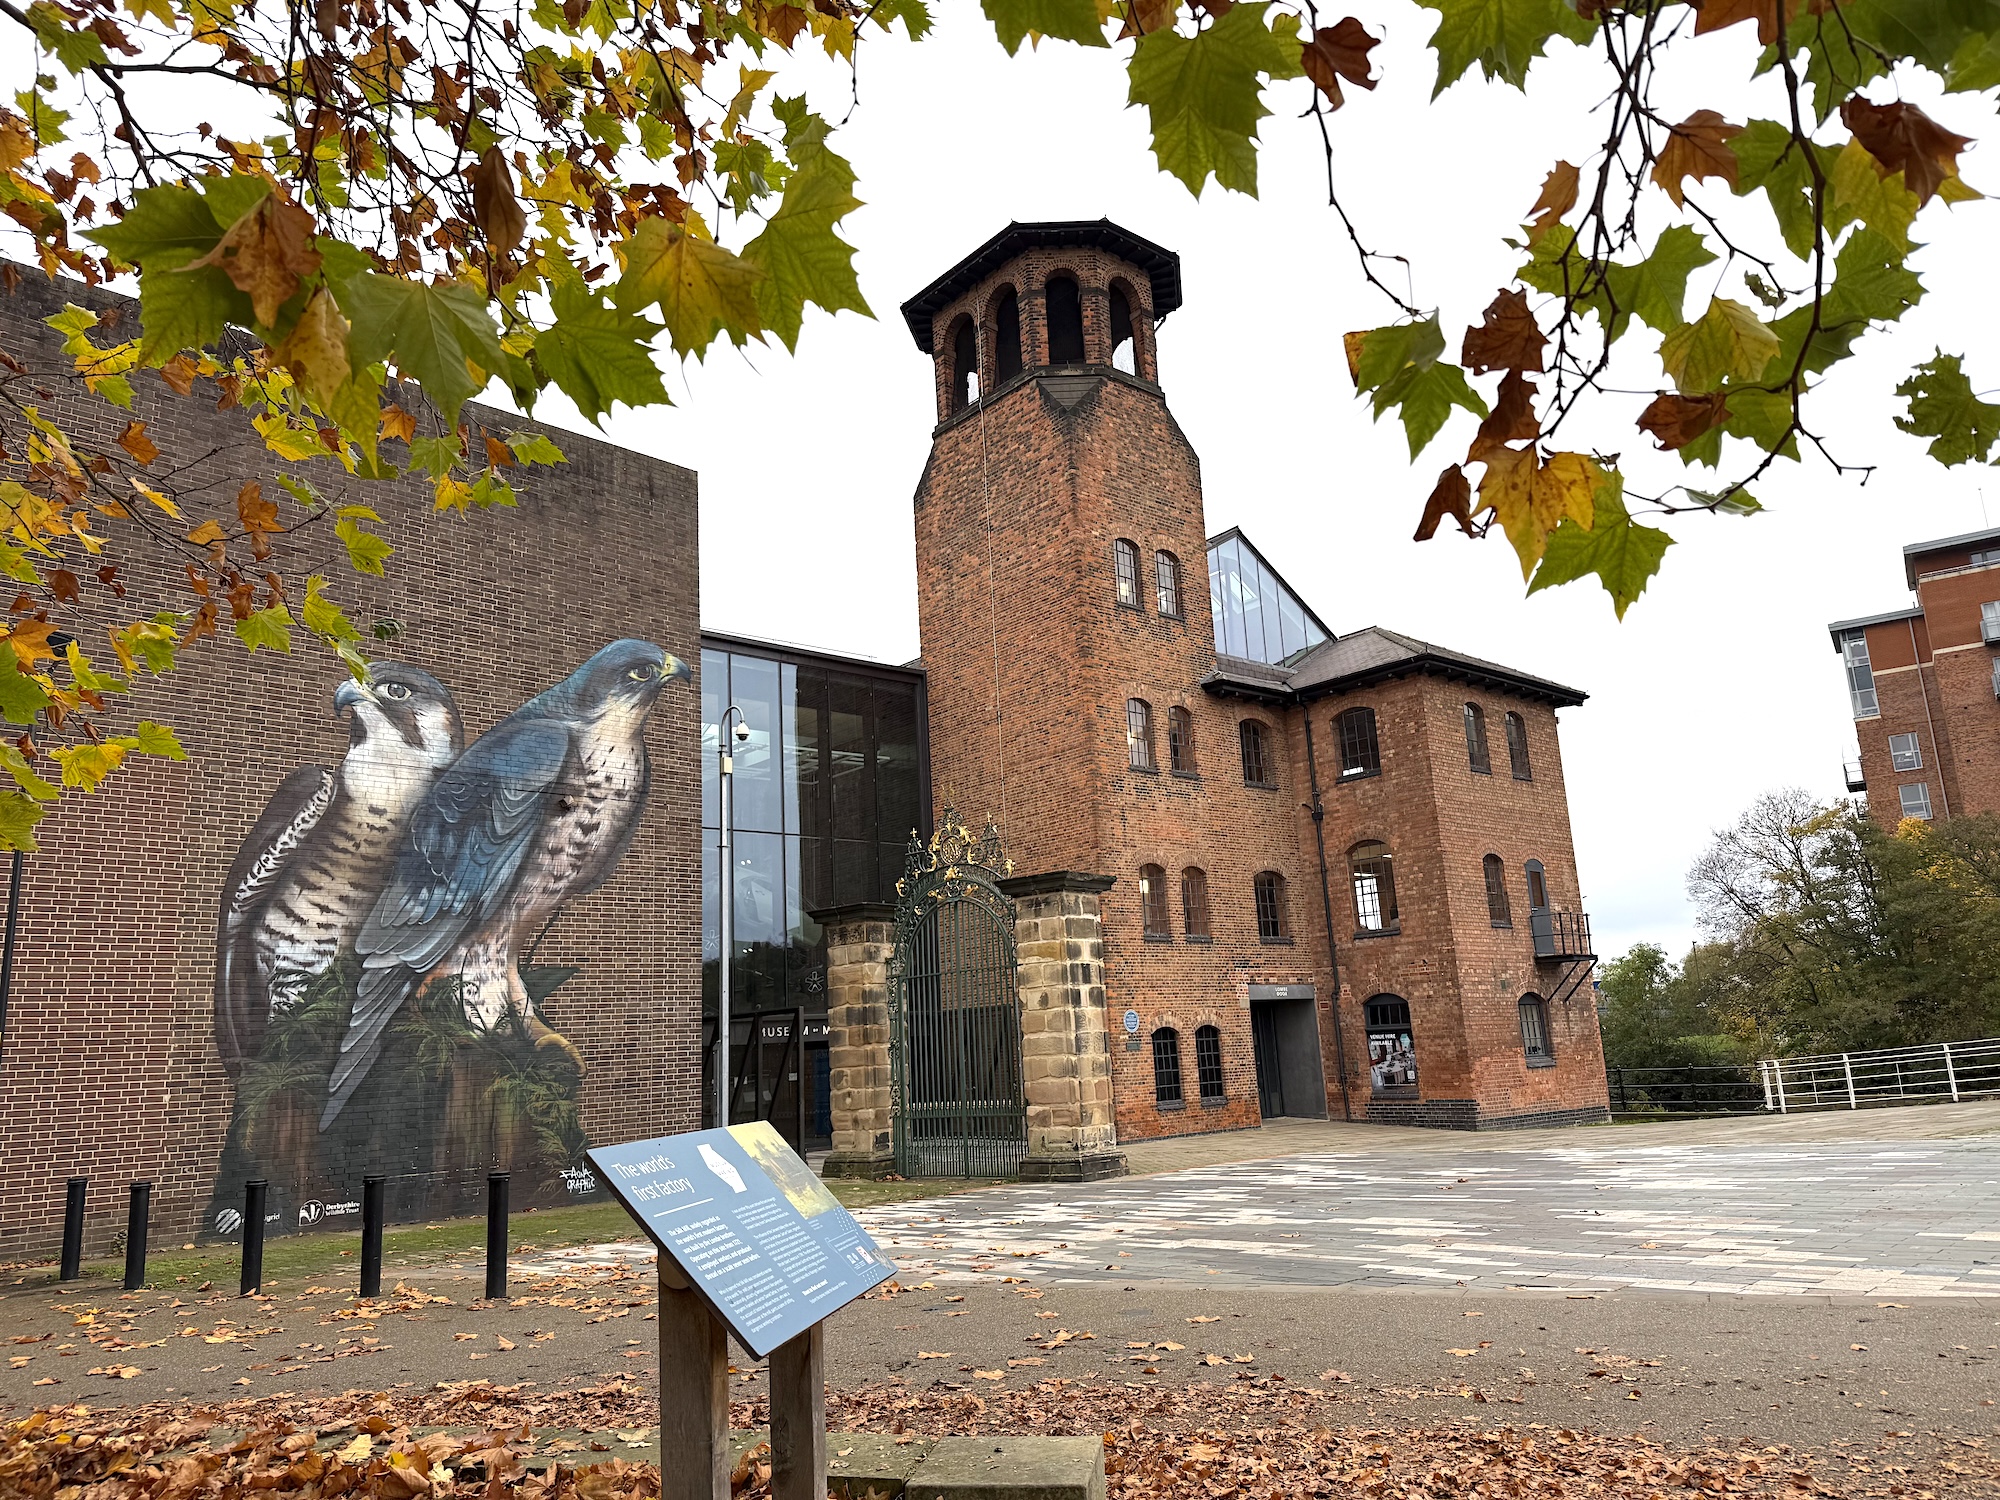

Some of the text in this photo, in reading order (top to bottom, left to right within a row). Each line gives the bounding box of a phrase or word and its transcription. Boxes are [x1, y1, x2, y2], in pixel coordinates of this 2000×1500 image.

[610, 1154, 676, 1179] The world's
[631, 1177, 695, 1202] first factory
[325, 1201, 361, 1211] Derbyshire
